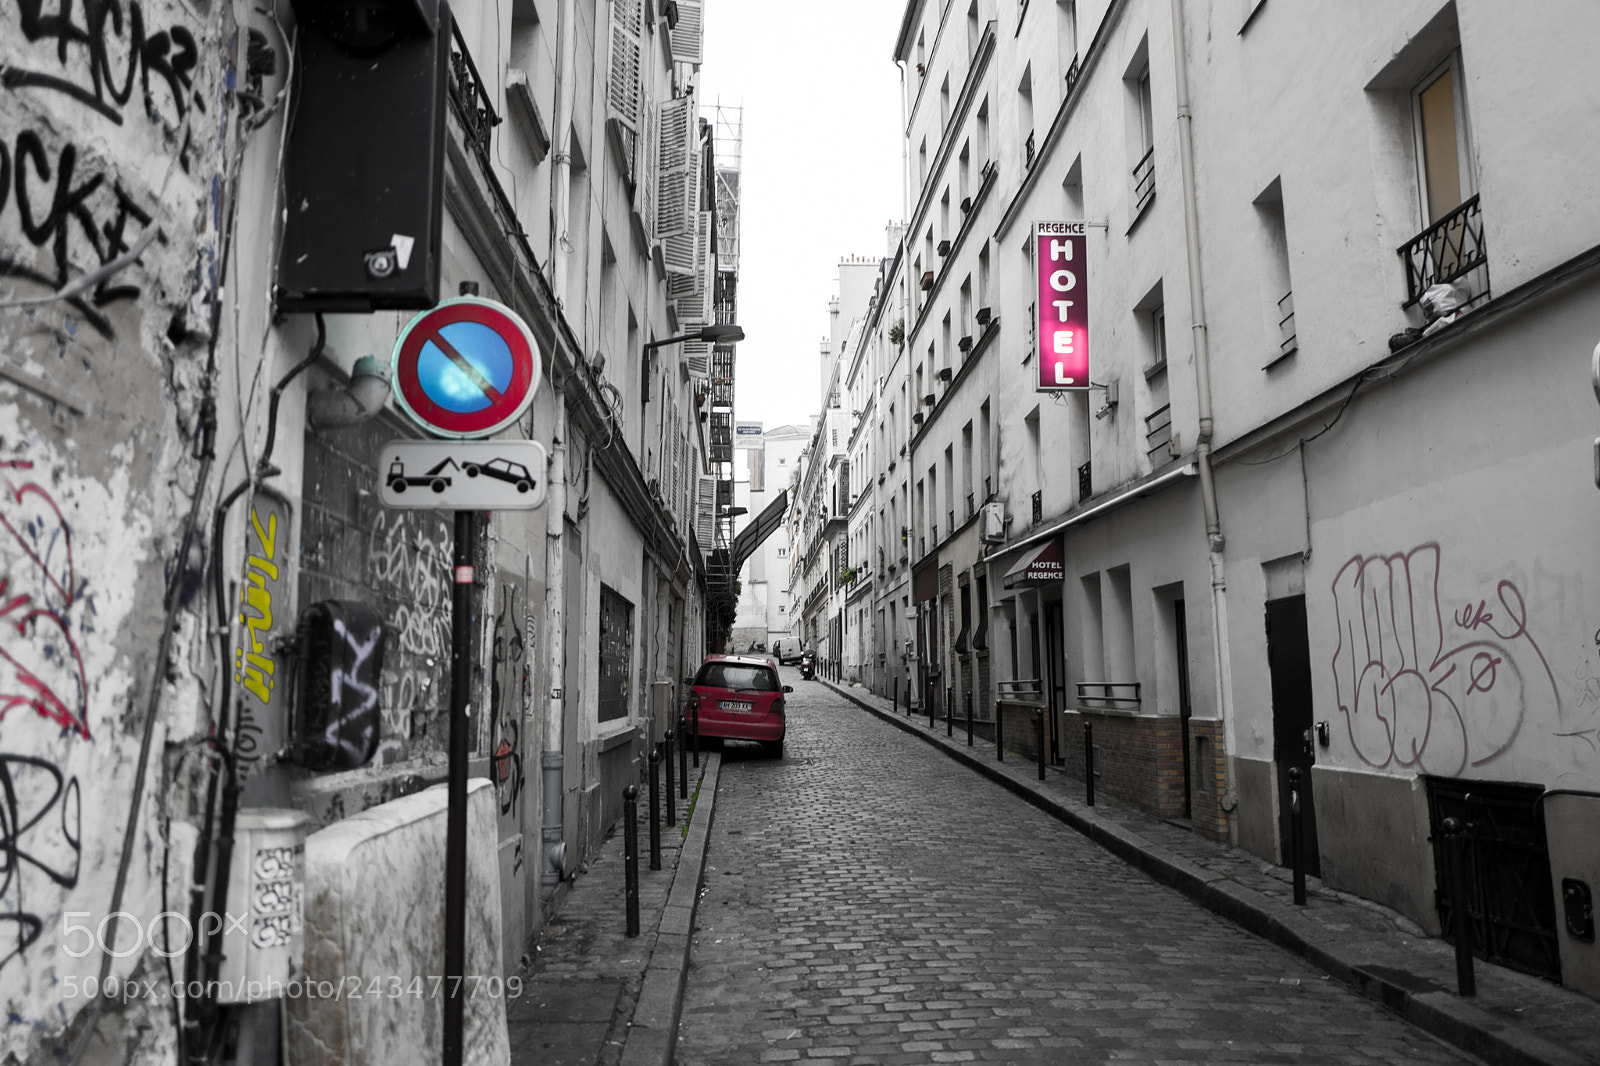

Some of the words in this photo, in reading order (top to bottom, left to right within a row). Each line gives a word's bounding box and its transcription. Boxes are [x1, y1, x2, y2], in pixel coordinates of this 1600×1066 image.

[1038, 222, 1085, 234] REGENCE
[1049, 238, 1077, 385] HOTEL
[1031, 561, 1063, 569] HOTEL
[1027, 571, 1064, 580] REGENCE
